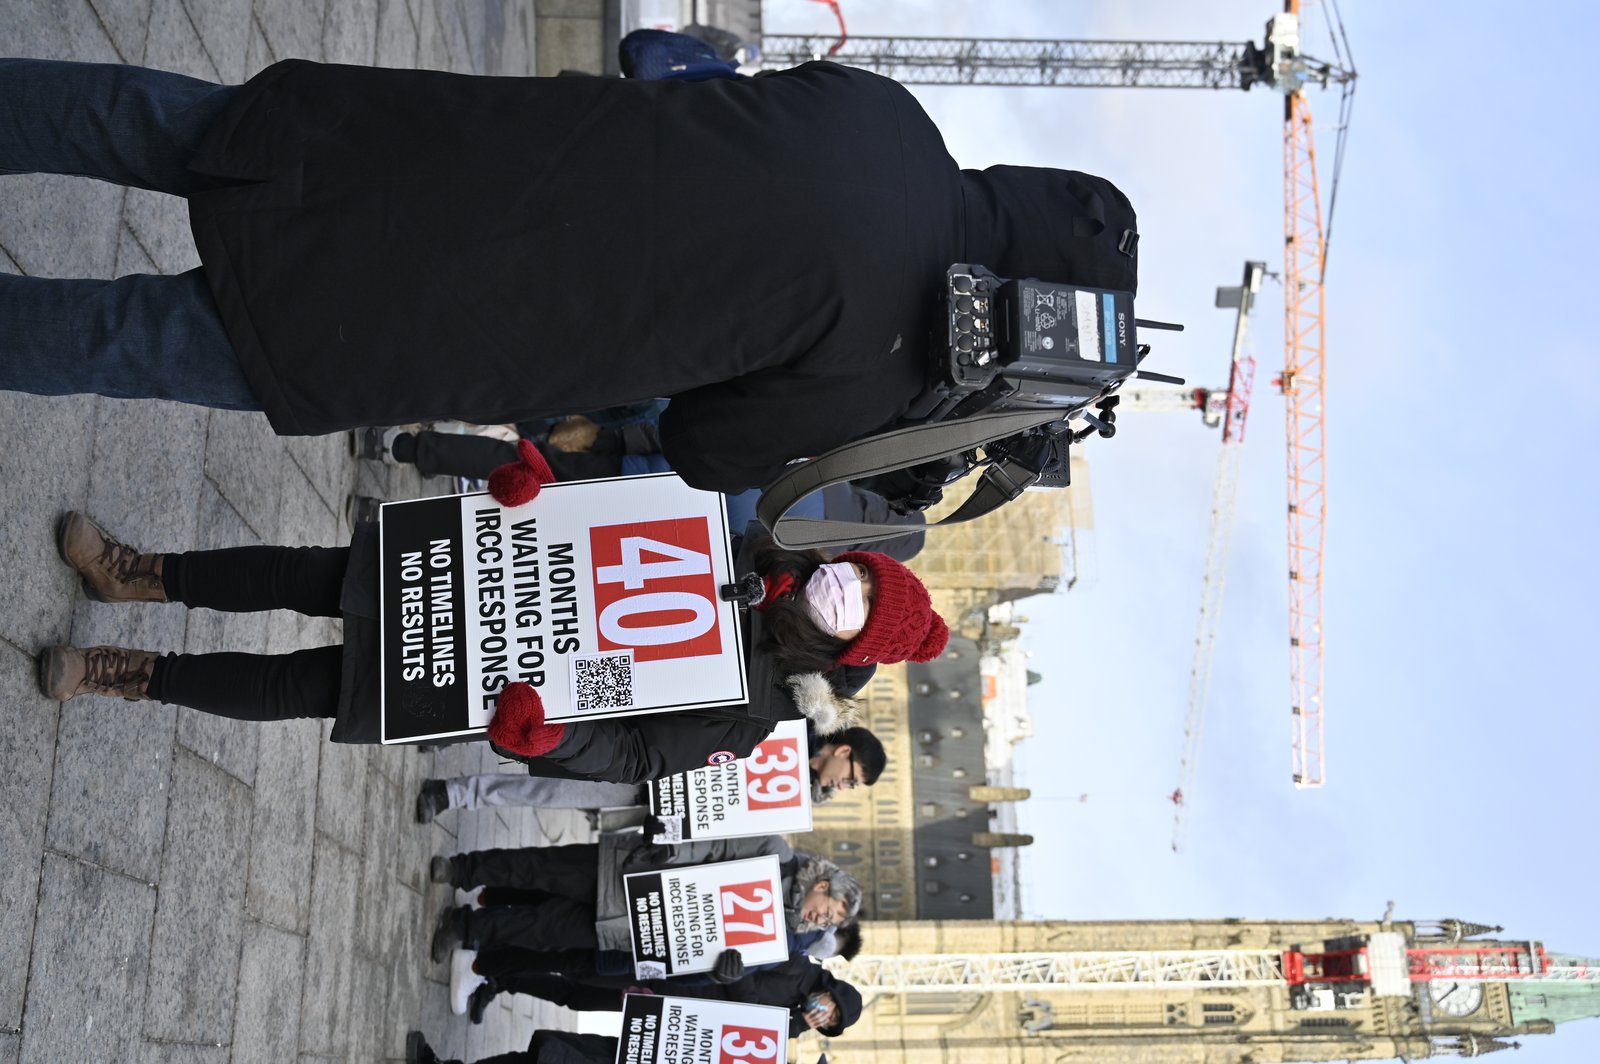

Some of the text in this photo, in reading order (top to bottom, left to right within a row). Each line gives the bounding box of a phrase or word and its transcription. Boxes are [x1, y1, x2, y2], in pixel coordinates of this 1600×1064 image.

[1118, 312, 1126, 346] SONY
[430, 539, 455, 687] NO TIMELINES
[475, 508, 508, 710] IRCC RESPONSE
[511, 519, 545, 687] WAITING FOR
[548, 543, 580, 654] MONTHS
[596, 536, 716, 646] 40
[401, 551, 425, 682] NO RESULTS
[658, 776, 672, 816] ESULTS
[672, 773, 686, 819] MELINES
[710, 764, 722, 792] TING
[726, 762, 740, 806] ONTHS
[746, 746, 800, 802] 39
[694, 770, 709, 830] ESPONSE
[712, 796, 724, 821] FOR
[636, 898, 652, 955] NO RESULTS
[648, 892, 666, 958] NO TIMELINES
[669, 878, 689, 966] IRCC RESPONSE
[685, 883, 704, 957] WAITING FOR
[702, 894, 718, 942] MONTHS
[722, 888, 775, 935] 27
[630, 1018, 642, 1033] NO
[644, 1015, 657, 1029] NO
[668, 1005, 682, 1031] IRCC
[682, 1014, 698, 1064] WAITING
[721, 1032, 777, 1064] 3
